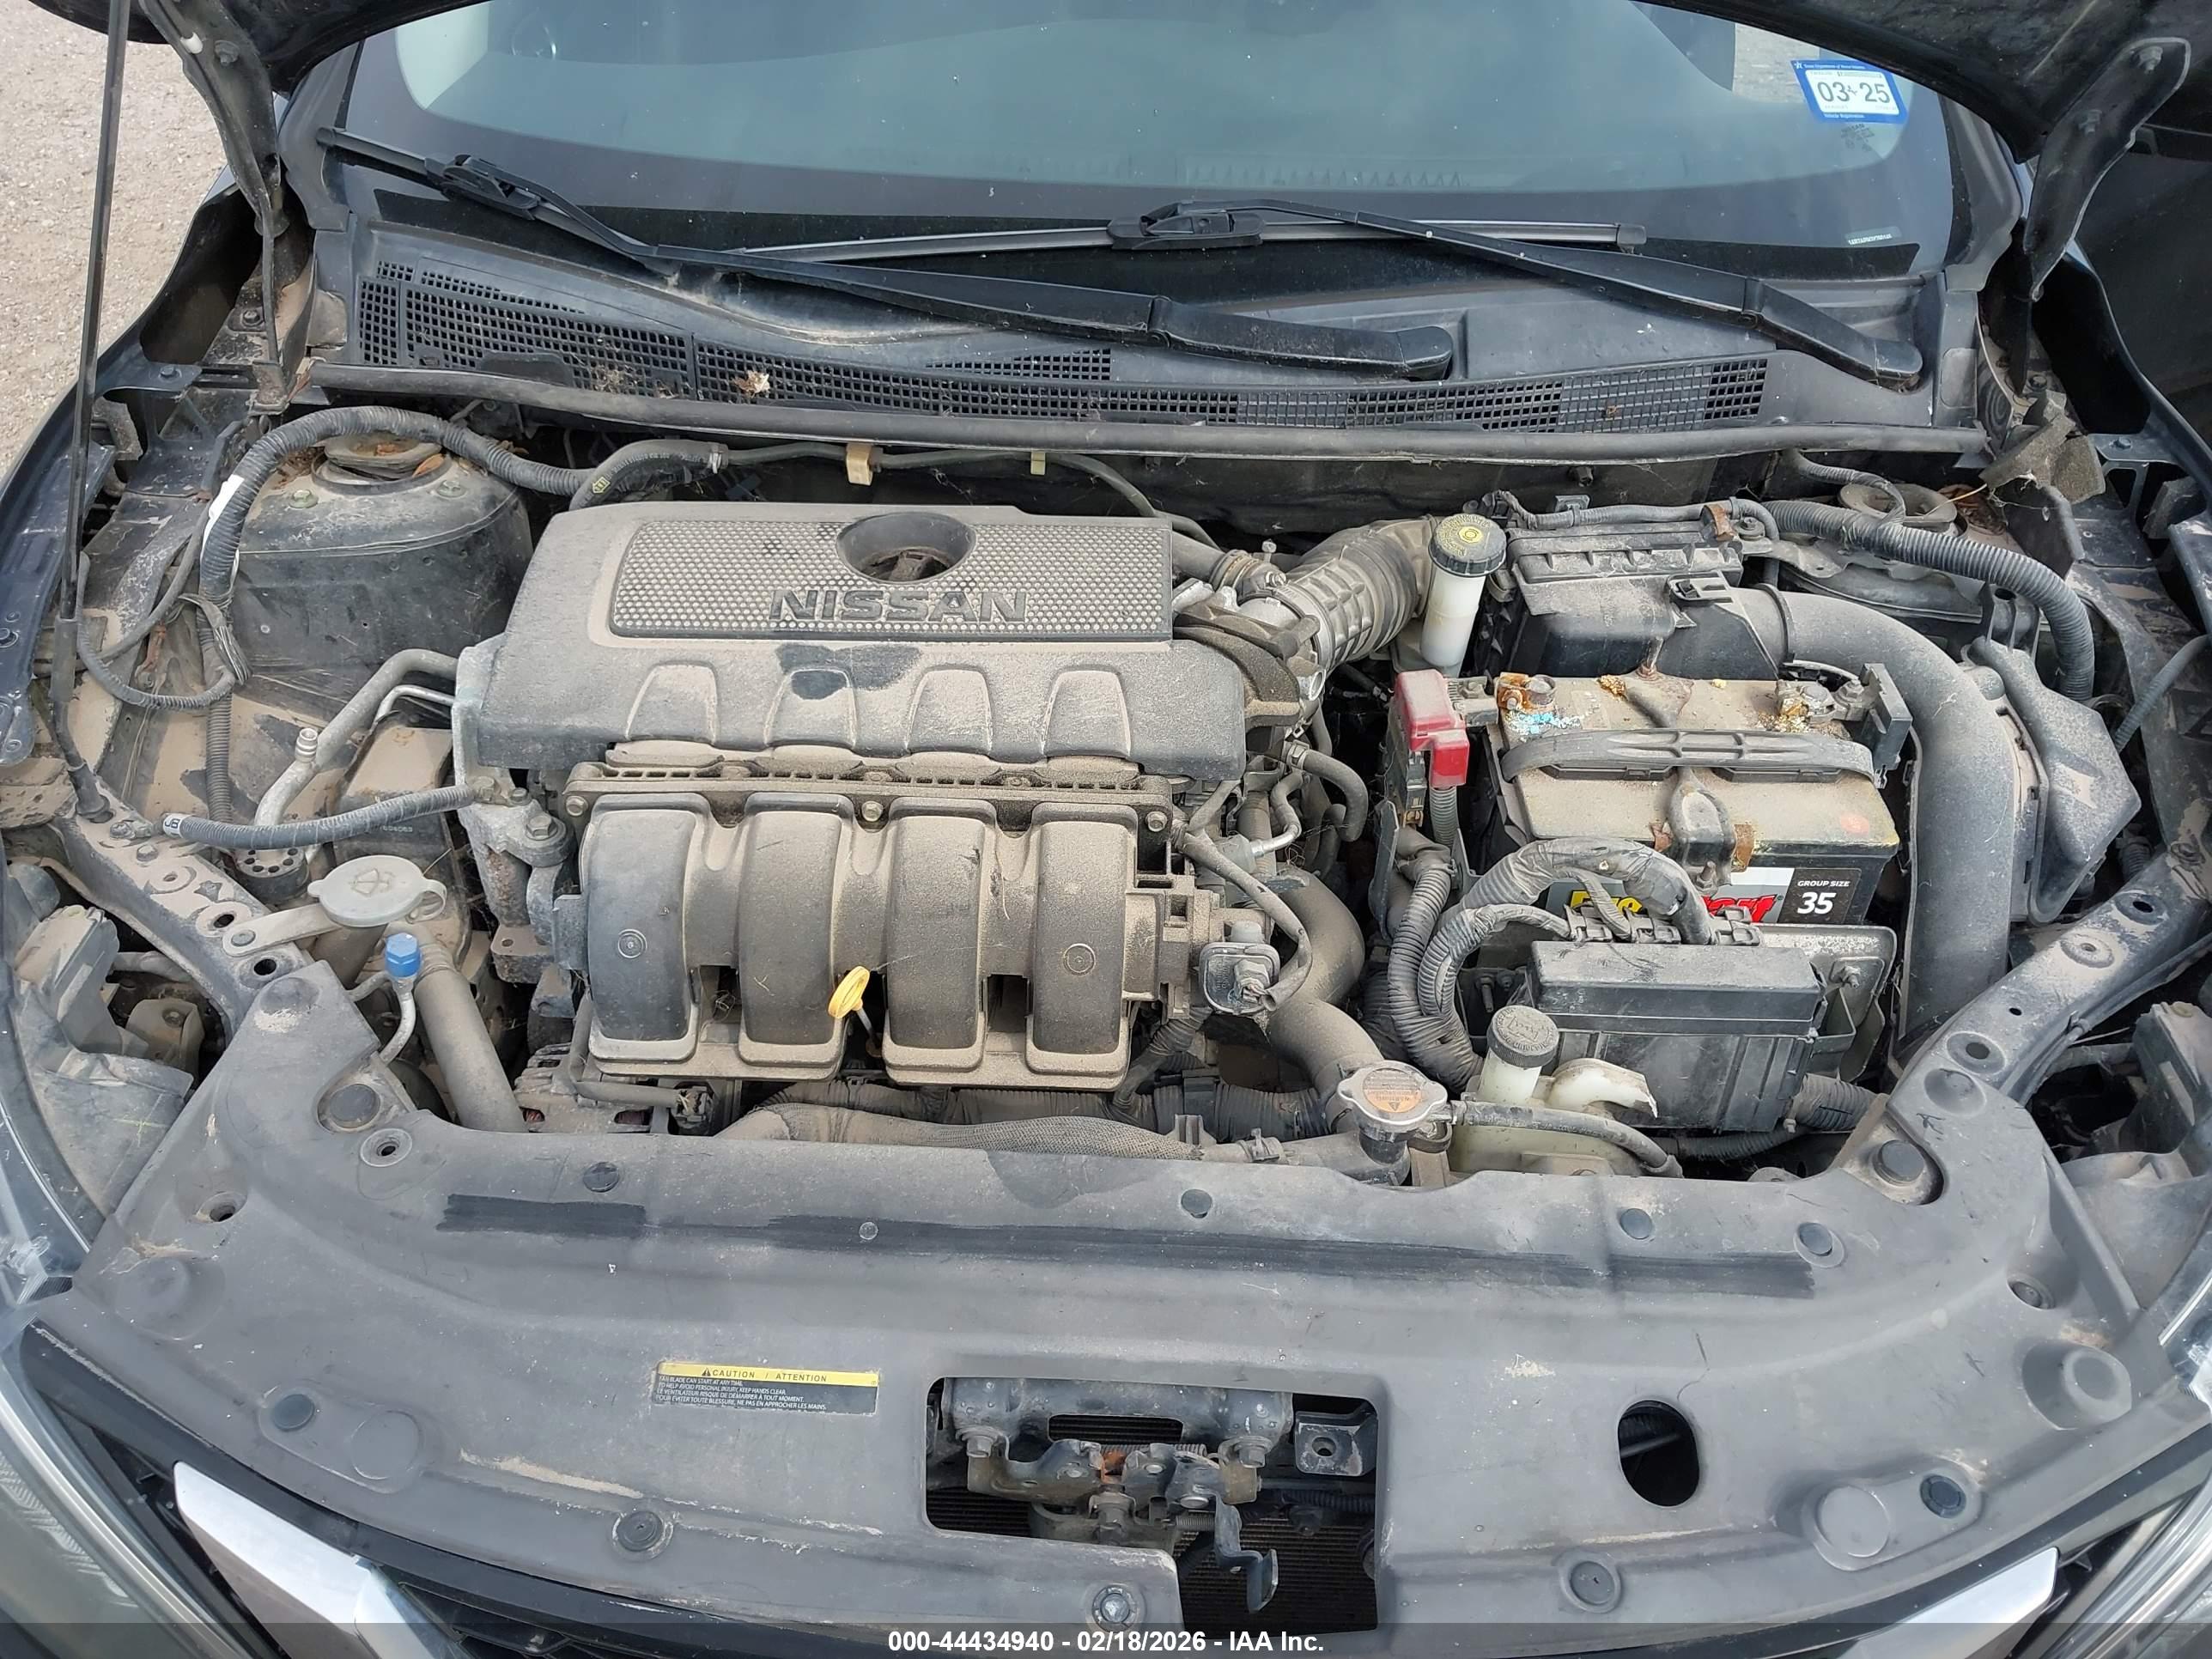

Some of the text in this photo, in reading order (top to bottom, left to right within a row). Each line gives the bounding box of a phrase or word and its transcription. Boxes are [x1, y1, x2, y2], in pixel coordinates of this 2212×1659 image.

[1817, 82, 1890, 103] 03 25
[769, 590, 1027, 623] NISSAN
[1797, 892, 1837, 915] 35
[712, 1370, 755, 1378] CAUTION
[775, 1373, 827, 1382] ATTENTION
